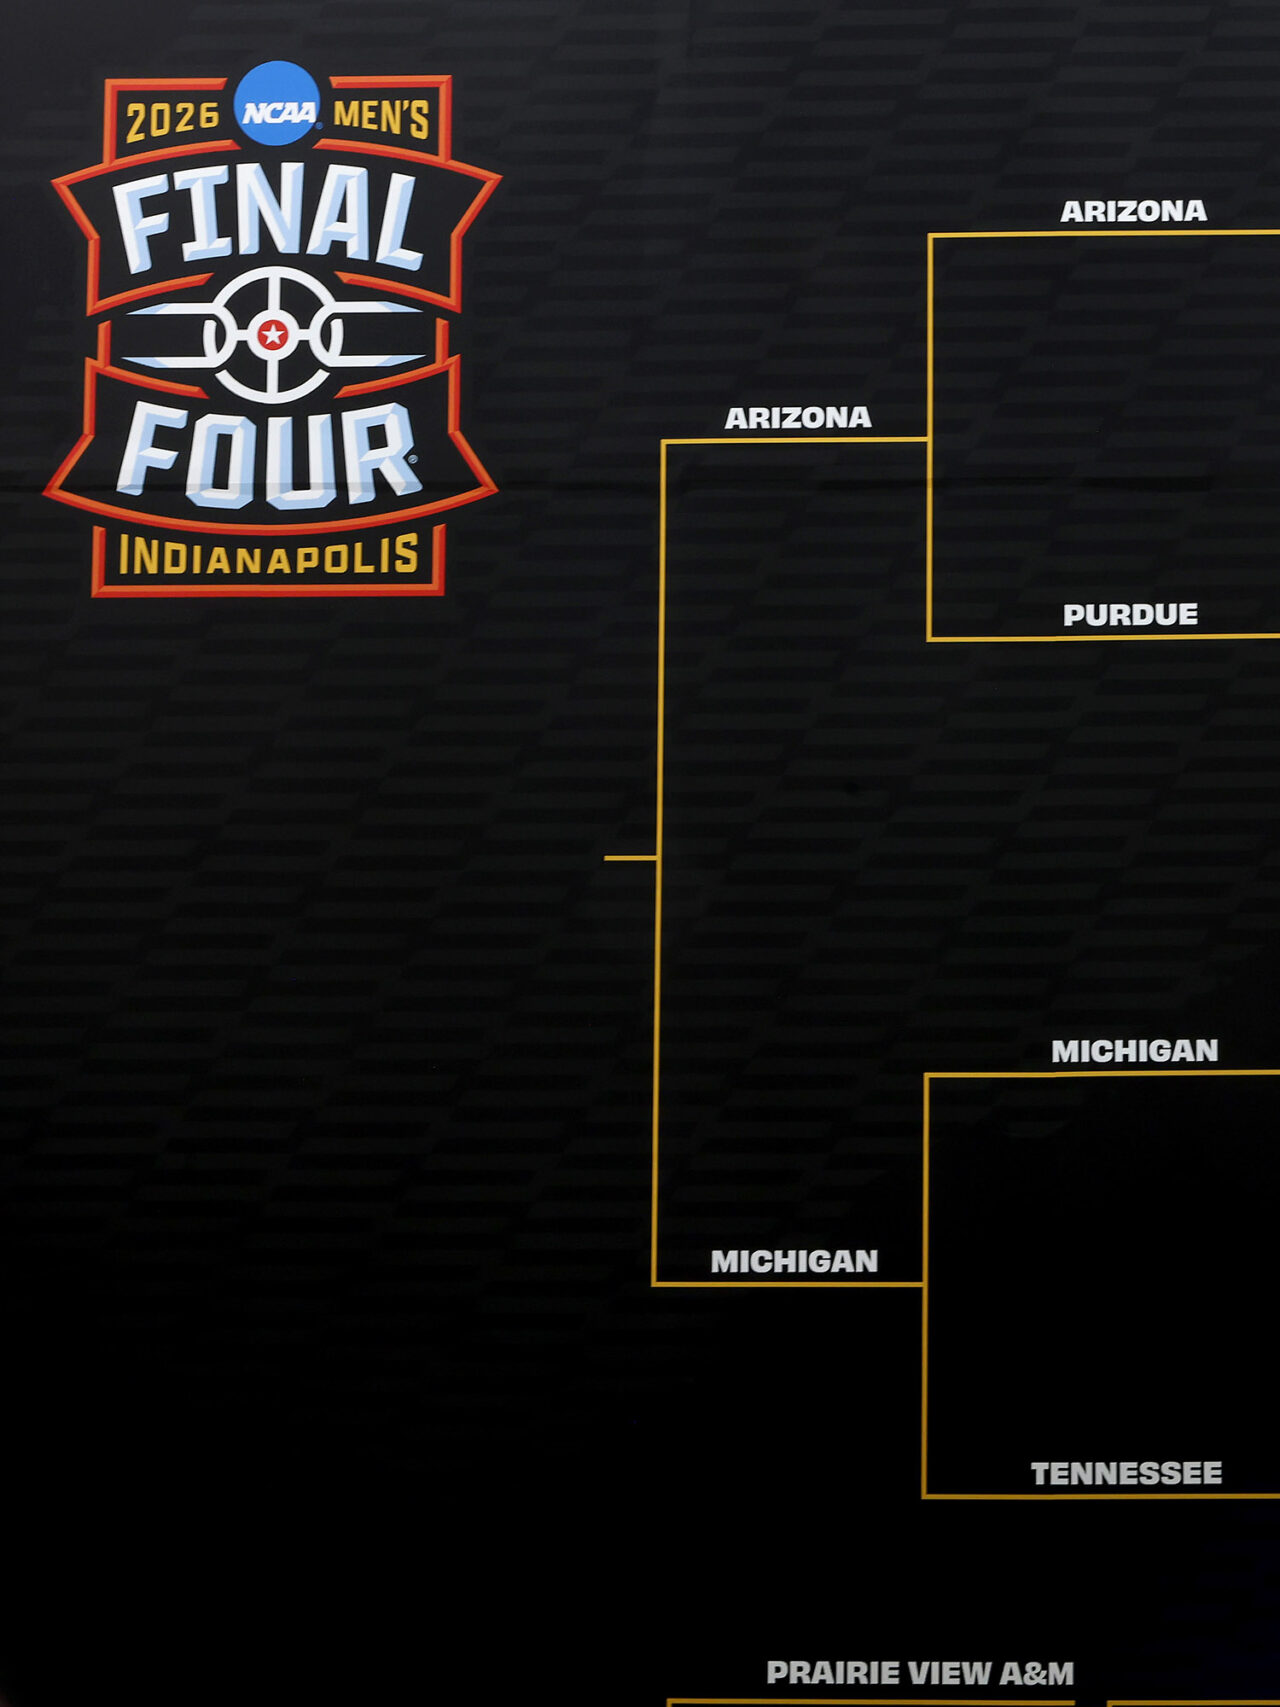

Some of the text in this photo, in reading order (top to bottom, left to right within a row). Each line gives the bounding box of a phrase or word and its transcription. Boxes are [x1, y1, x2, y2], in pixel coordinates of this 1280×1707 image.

[126, 102, 219, 143] 2026
[242, 101, 318, 125] NCAA
[333, 98, 430, 139] MEN'S
[111, 162, 424, 274] FINAL
[1059, 199, 1208, 223] ARIZONA
[724, 406, 873, 430] ARIZONA
[116, 401, 424, 510] FOUR
[118, 532, 419, 575] INDIANAPOLIS
[1063, 602, 1198, 627] PURDUE
[1052, 1039, 1218, 1063] MICHIGAN
[711, 1249, 878, 1273] MICHIGAN
[1031, 1461, 1222, 1485] TENNESSEE
[767, 1660, 1074, 1686] PRAIRIE VIEW A&M
